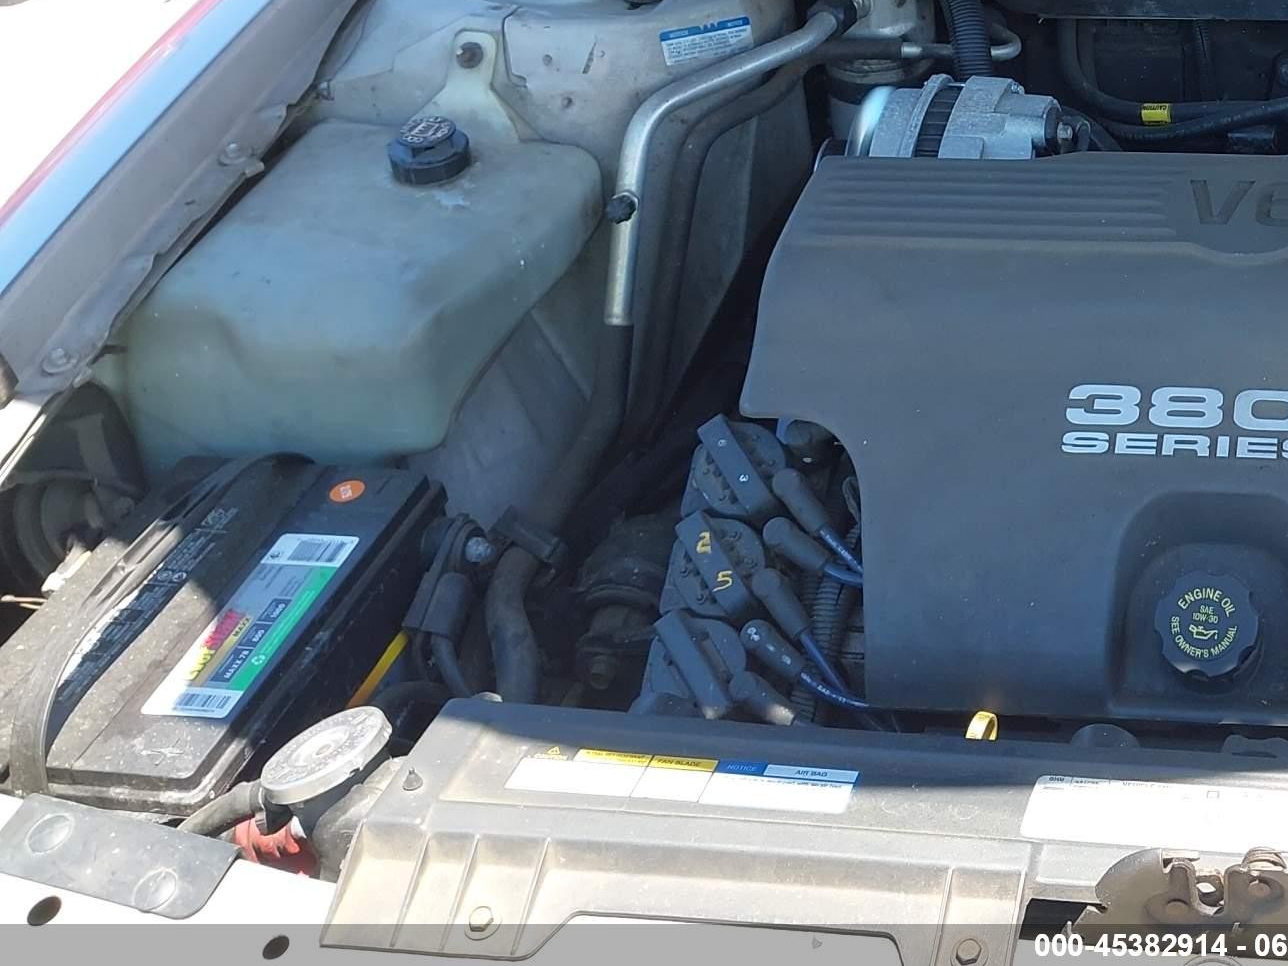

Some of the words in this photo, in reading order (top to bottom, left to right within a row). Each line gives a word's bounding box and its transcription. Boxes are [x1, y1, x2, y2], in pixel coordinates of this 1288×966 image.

[695, 531, 712, 555] 2
[711, 570, 733, 592] 5
[1177, 587, 1223, 610] ENGINE
[1220, 597, 1236, 618] OIL
[1200, 605, 1214, 614] SAE
[1171, 616, 1181, 635] SEE
[1174, 634, 1210, 659] OWNER'S
[1210, 625, 1238, 656] MANUAL
